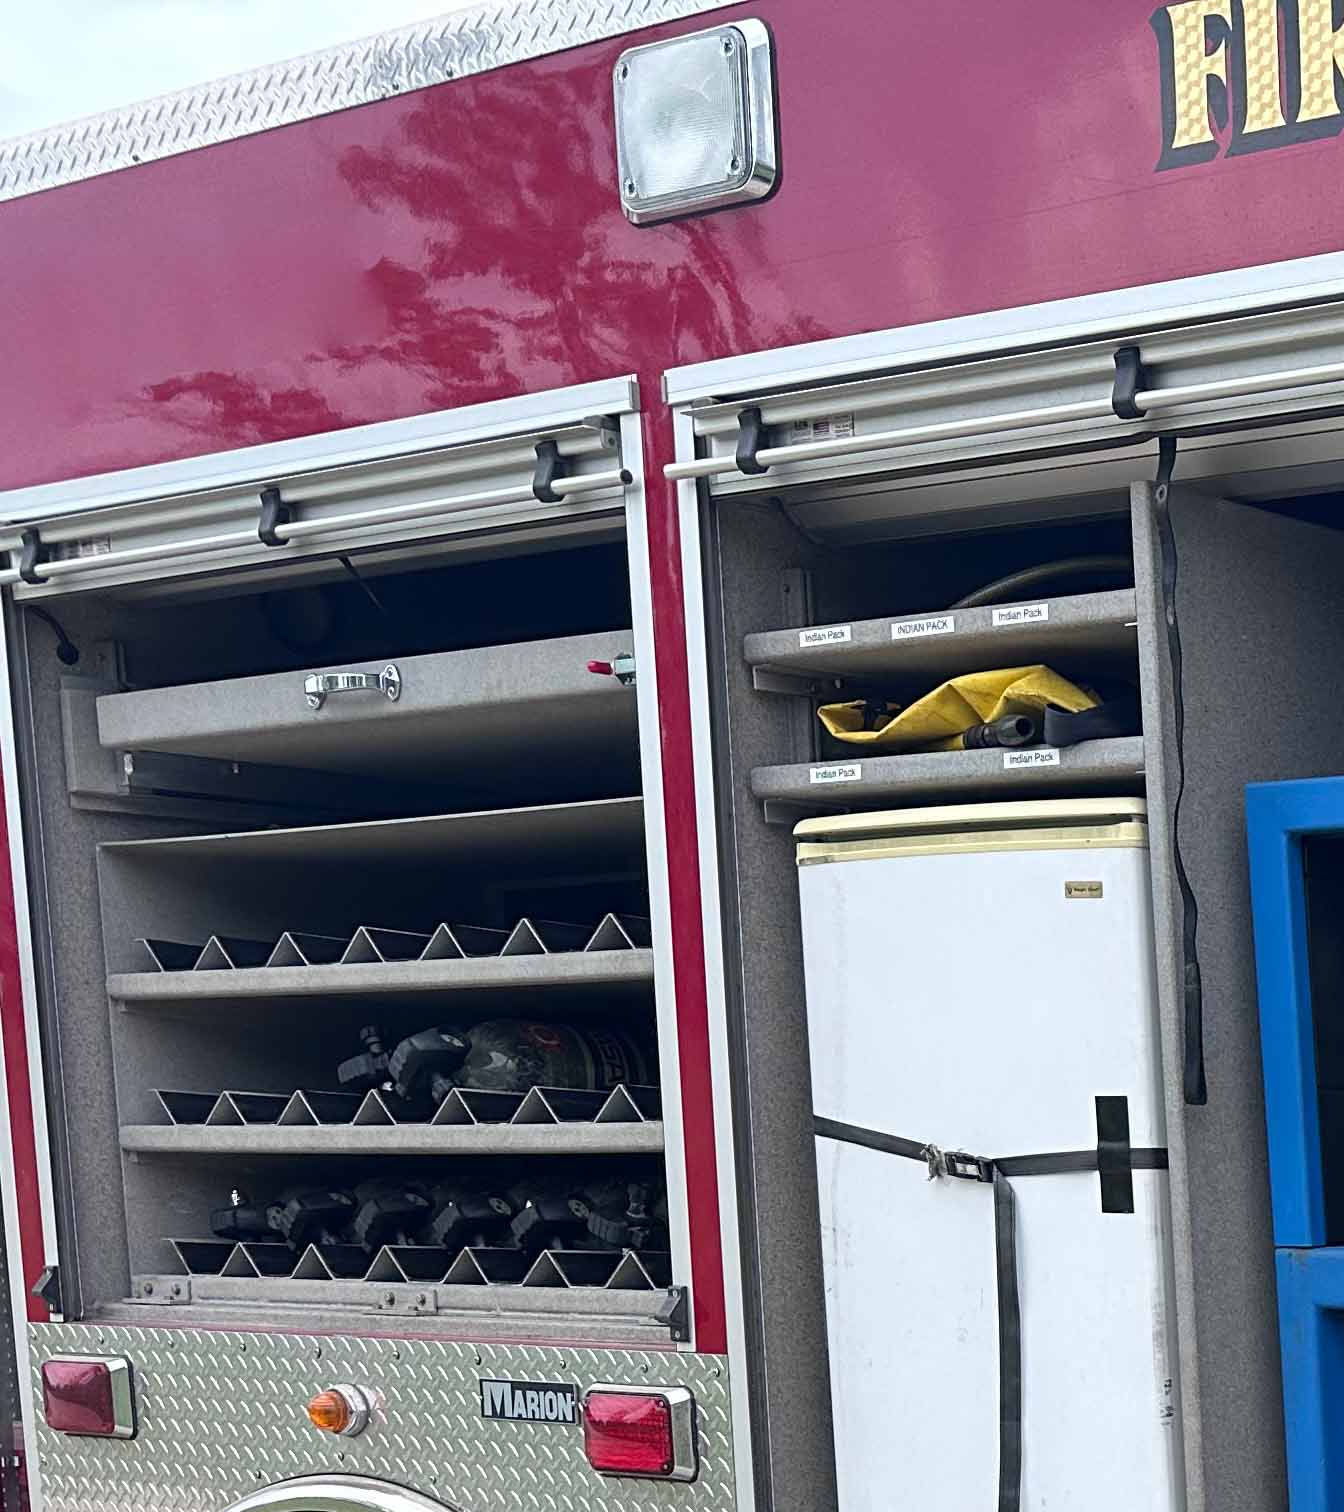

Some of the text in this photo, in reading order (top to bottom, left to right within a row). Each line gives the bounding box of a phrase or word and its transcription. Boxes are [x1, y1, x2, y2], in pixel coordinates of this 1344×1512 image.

[998, 608, 1042, 622] Indian Pack
[897, 619, 949, 635] INDIAN PACK
[804, 629, 845, 643] Indian Pack
[1009, 751, 1054, 765] Indian Pack
[815, 767, 856, 780] Indian Pack
[481, 1380, 574, 1422] MARION
